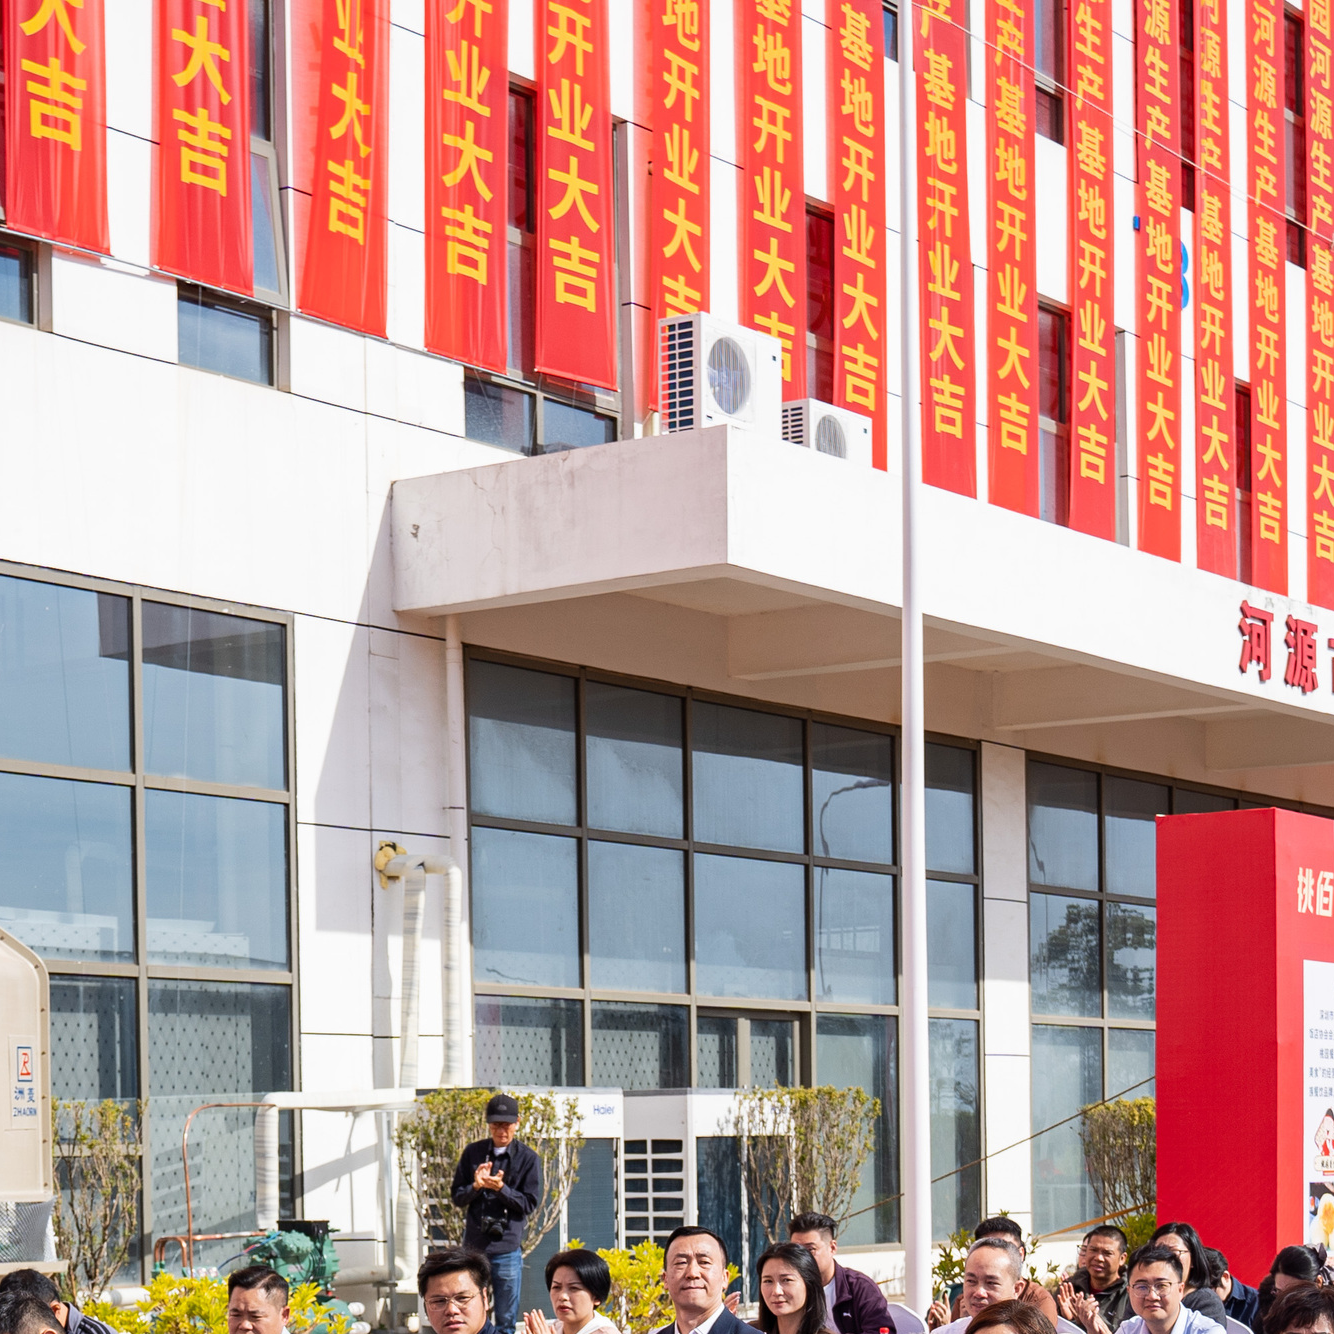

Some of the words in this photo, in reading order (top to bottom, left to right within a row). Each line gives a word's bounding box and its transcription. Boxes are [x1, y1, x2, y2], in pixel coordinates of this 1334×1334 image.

[171, 0, 233, 198] 大吉
[839, 3, 880, 412] 基地开业大吉
[1251, 0, 1283, 545] 河源生产基地开业大吉
